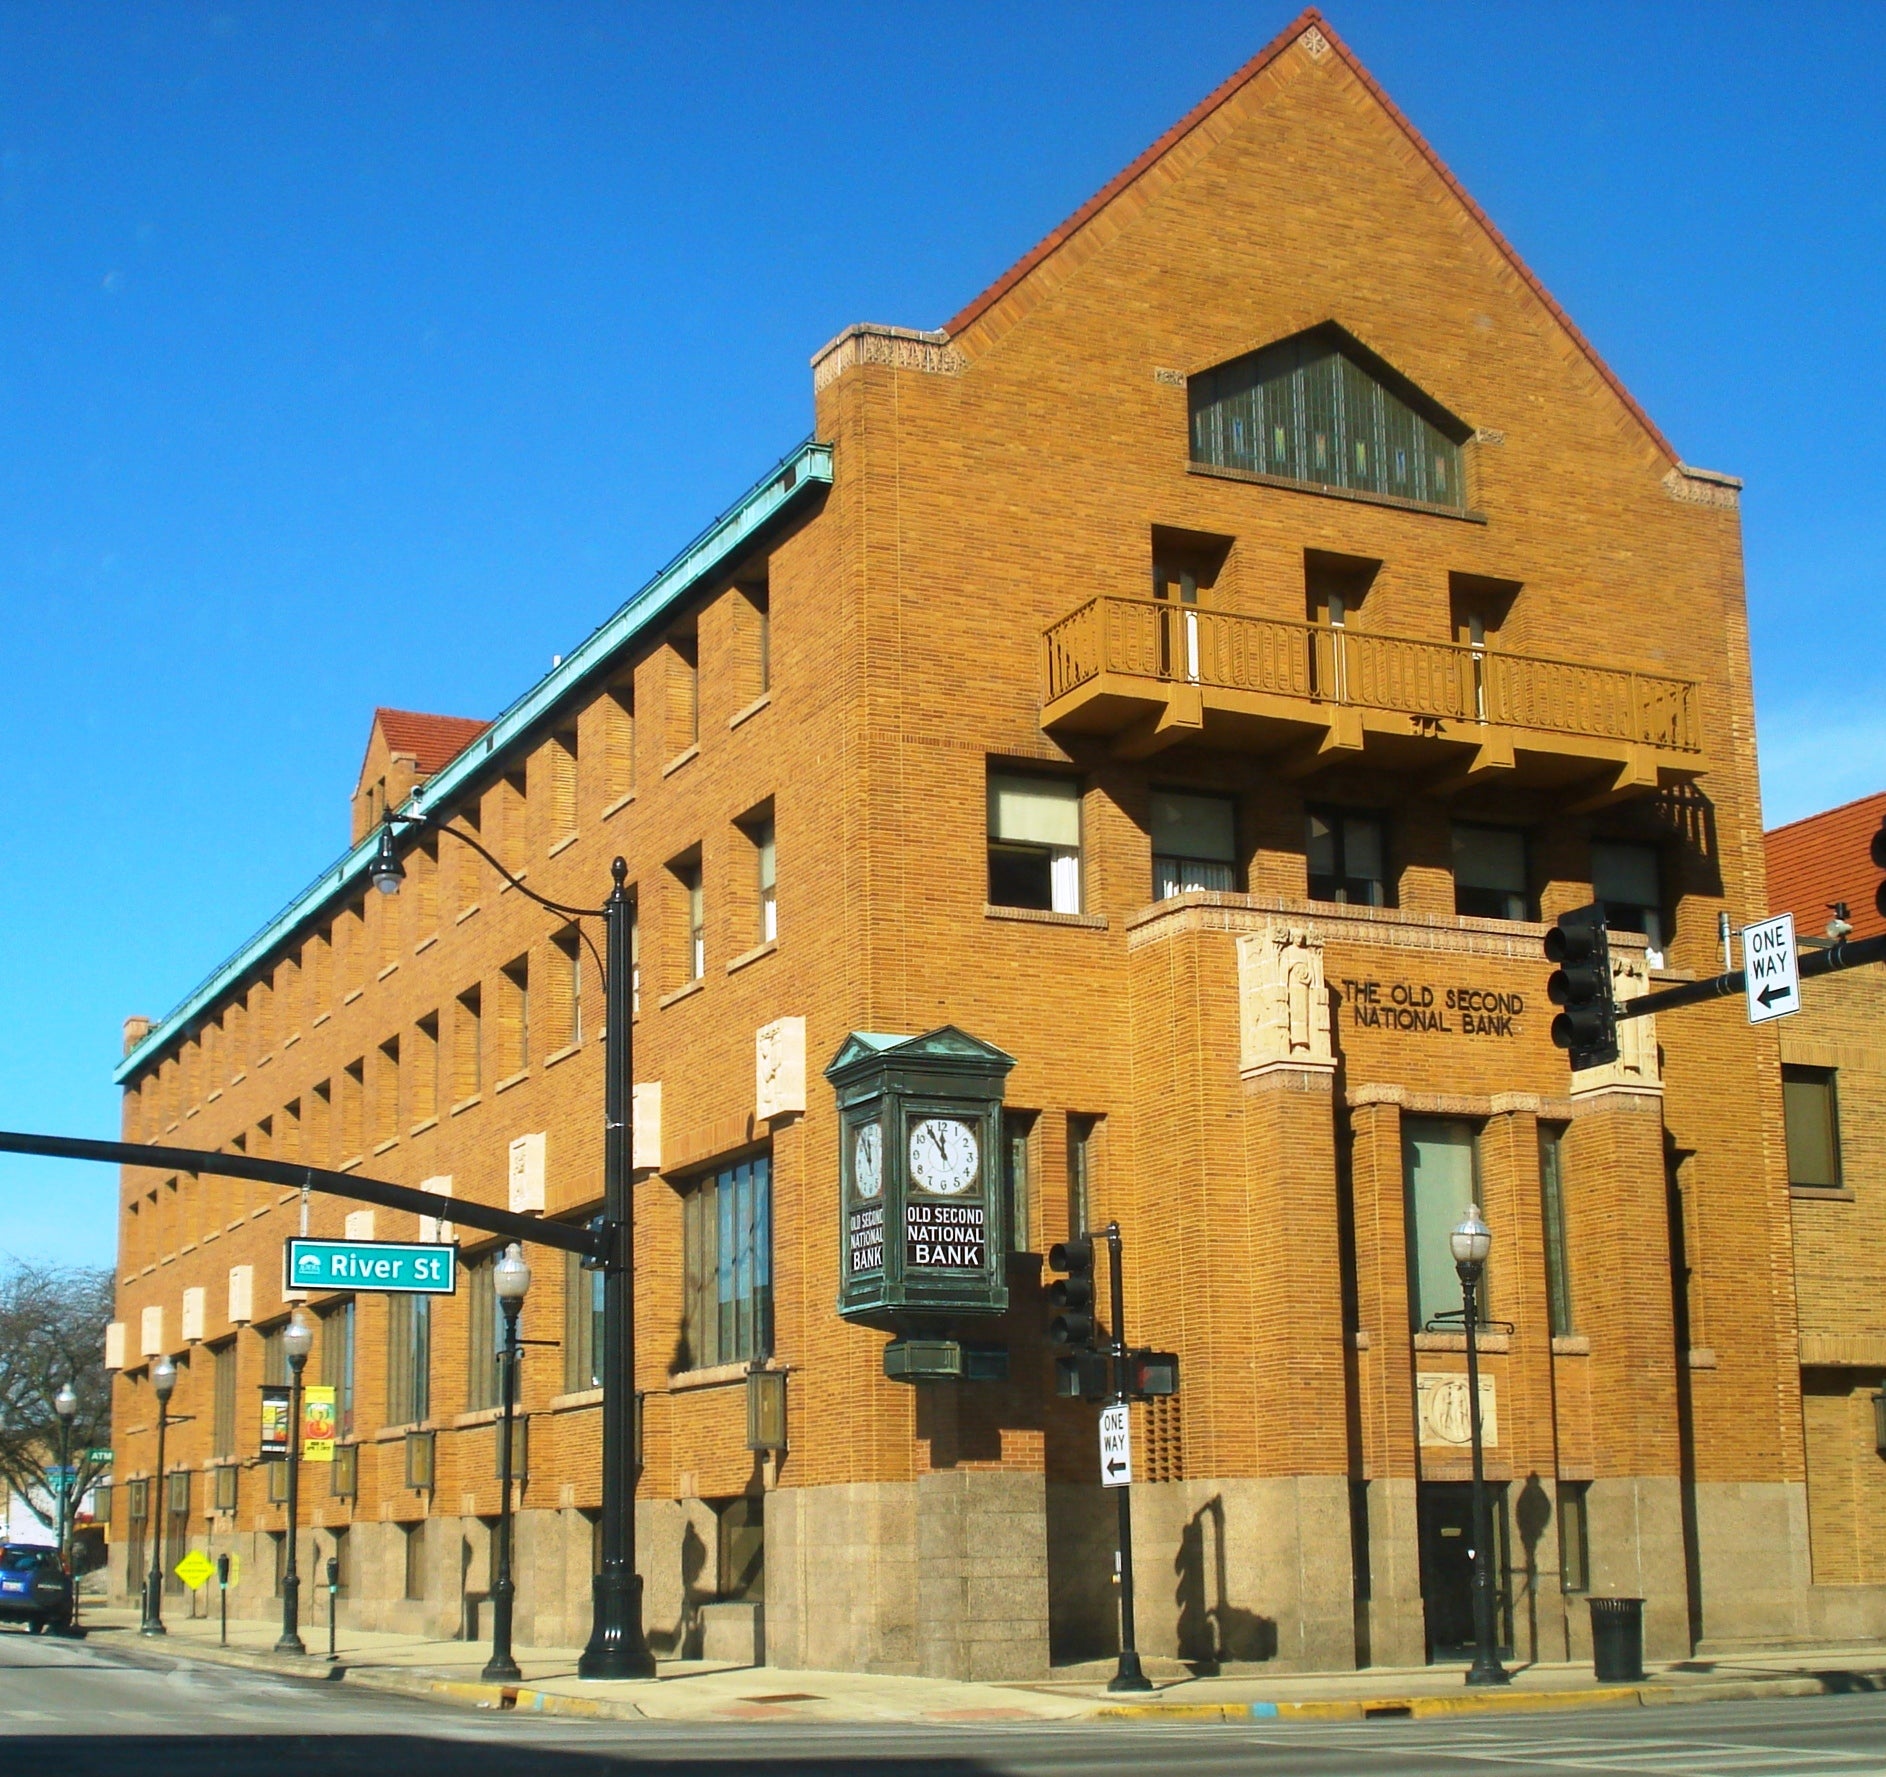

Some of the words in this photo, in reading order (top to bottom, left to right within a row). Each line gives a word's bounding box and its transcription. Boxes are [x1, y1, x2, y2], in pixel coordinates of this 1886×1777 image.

[1753, 926, 1785, 953] ONE
[1753, 951, 1787, 980] WAY
[1341, 979, 1381, 1004] THE
[1391, 984, 1434, 1008] OLD
[1445, 989, 1524, 1015] SECOND
[1354, 1005, 1452, 1033] NATIONAL
[1462, 1013, 1513, 1037] BANK
[938, 1122, 948, 1132] 12
[916, 1134, 926, 1144] 10
[962, 1137, 969, 1148] 2
[966, 1152, 974, 1163] 3
[917, 1164, 923, 1175] 8
[963, 1167, 970, 1177] 4
[927, 1175, 933, 1186] 7
[940, 1180, 947, 1191] 6
[953, 1177, 960, 1187] 5
[851, 1214, 861, 1231] OLD
[907, 1206, 931, 1223] OLD
[935, 1208, 984, 1225] SECOND
[851, 1227, 884, 1249] NATIONAL
[907, 1225, 985, 1243] NATIONAL
[853, 1246, 882, 1271] BANK
[915, 1244, 979, 1265] BANK
[331, 1253, 403, 1279] River
[413, 1257, 441, 1280] St
[1104, 1413, 1124, 1431] ONE
[1104, 1434, 1125, 1452] WAY
[90, 1451, 113, 1461] ATM
